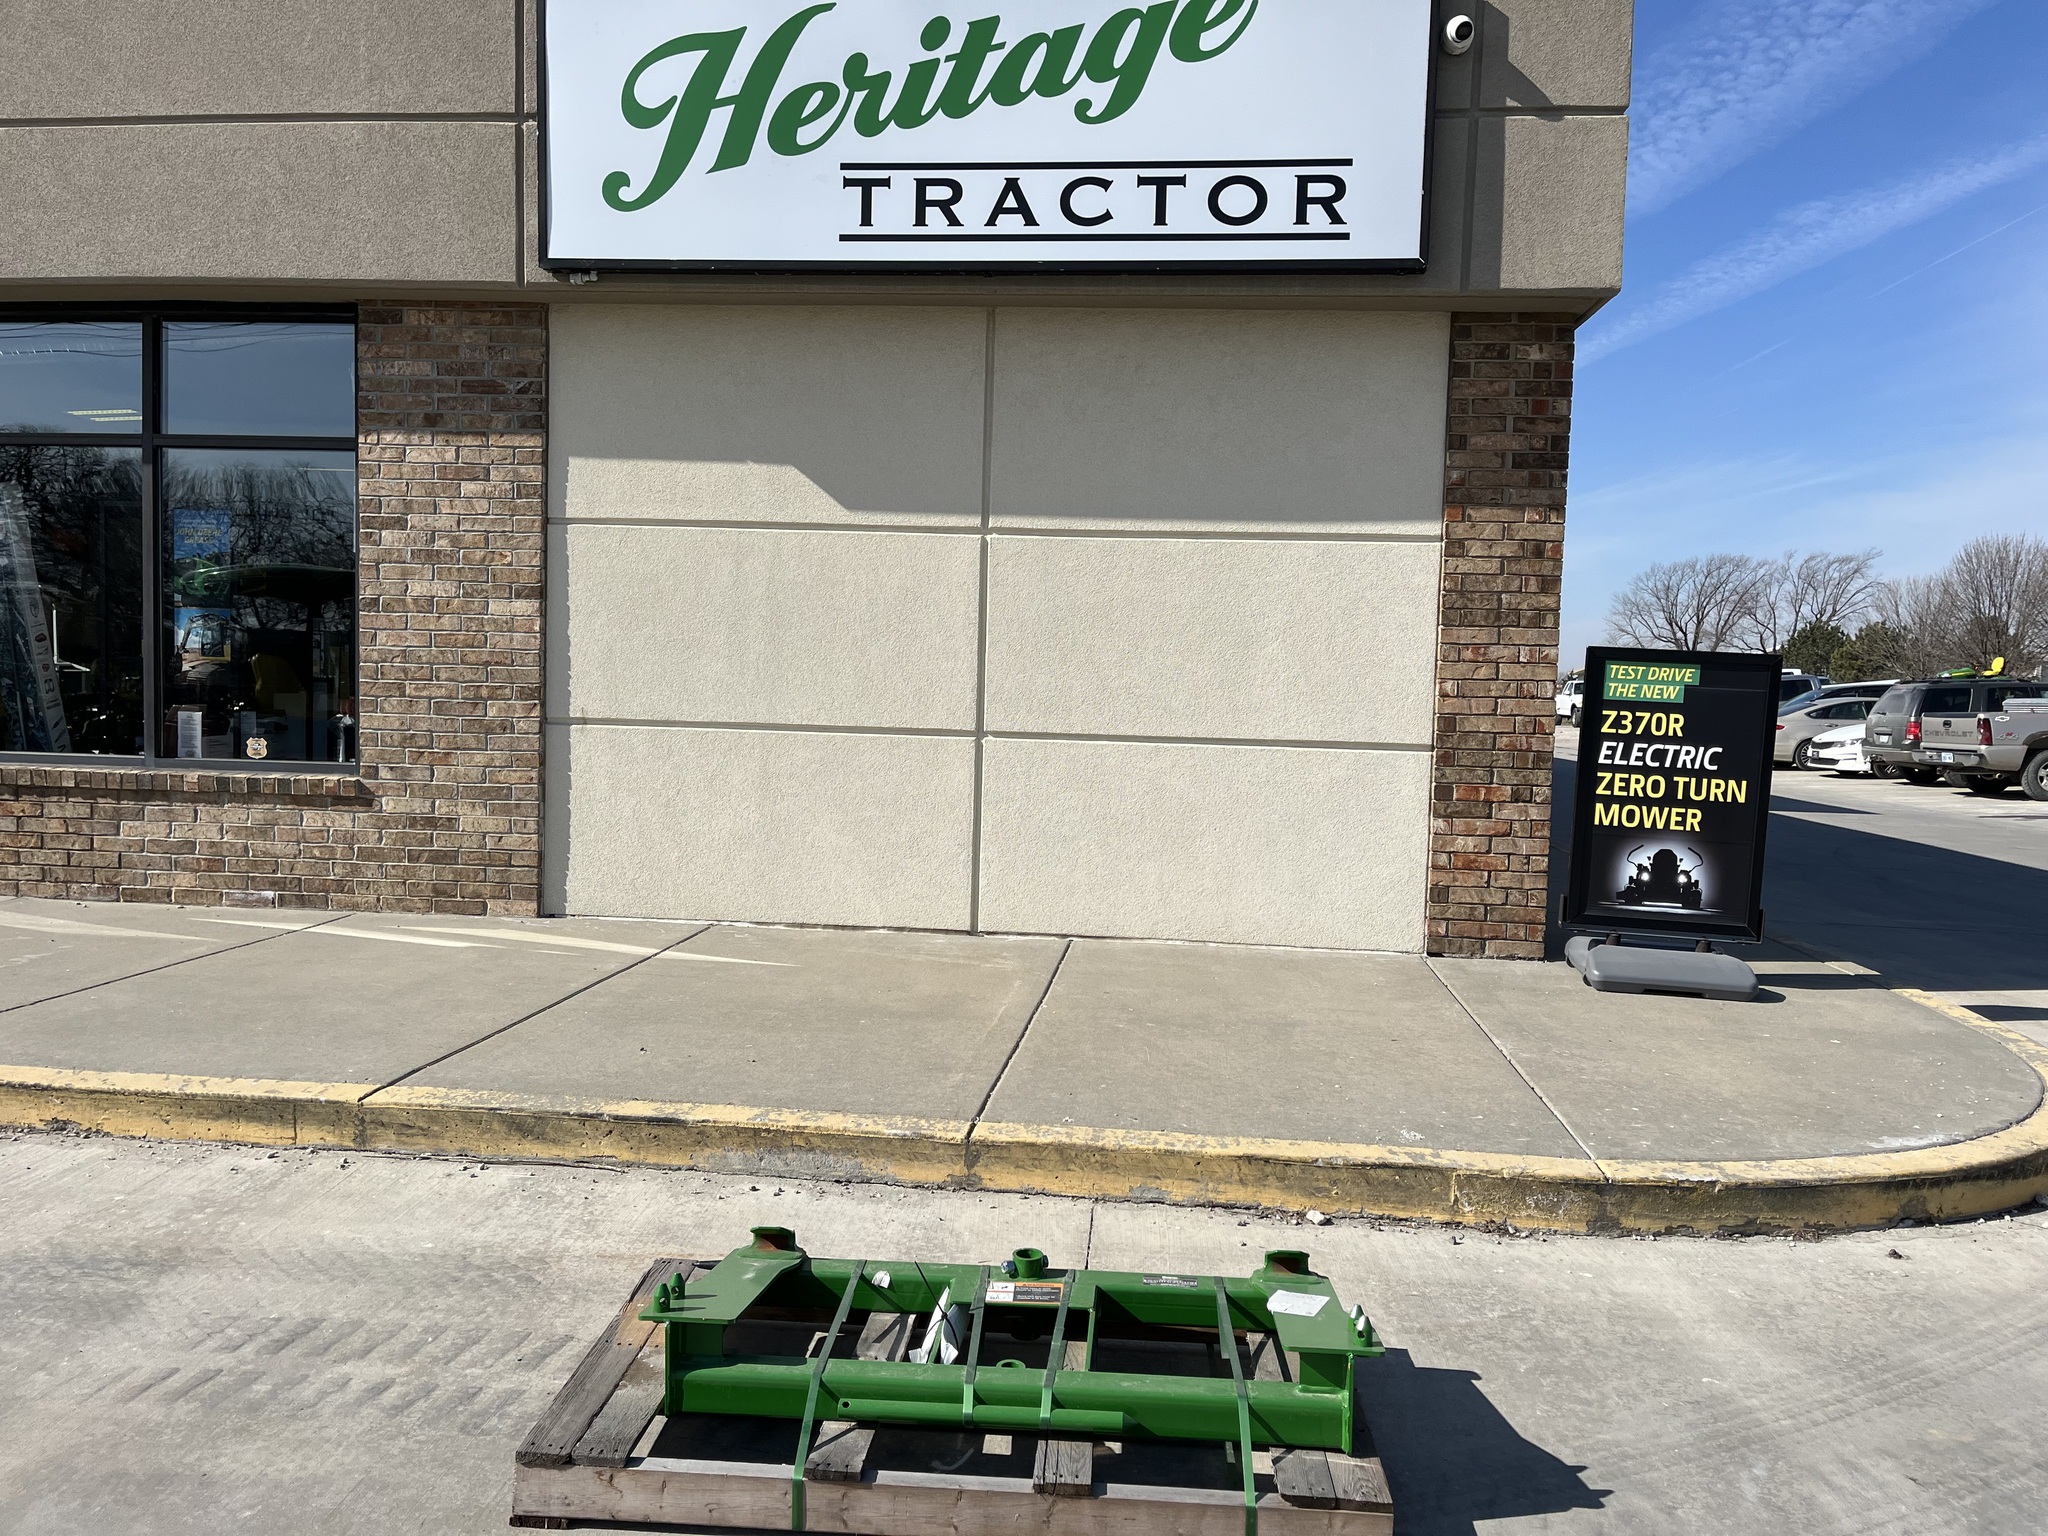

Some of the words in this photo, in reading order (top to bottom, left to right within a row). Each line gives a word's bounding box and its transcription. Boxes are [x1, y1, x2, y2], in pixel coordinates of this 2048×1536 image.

[602, 0, 1258, 212] Heritage
[842, 173, 1348, 228] TRACTOR
[1609, 664, 1646, 681] TEST
[1648, 666, 1696, 683] DRIVE
[1607, 683, 1637, 698] THE
[1640, 684, 1681, 700] NEW
[1600, 709, 1685, 737] Z370R
[1924, 729, 1974, 738] CHEVROLET
[1597, 741, 1723, 771] ELECTRIC
[1595, 772, 1666, 799] ZERO
[1673, 776, 1748, 804] TURN
[1594, 802, 1703, 832] MOWER
